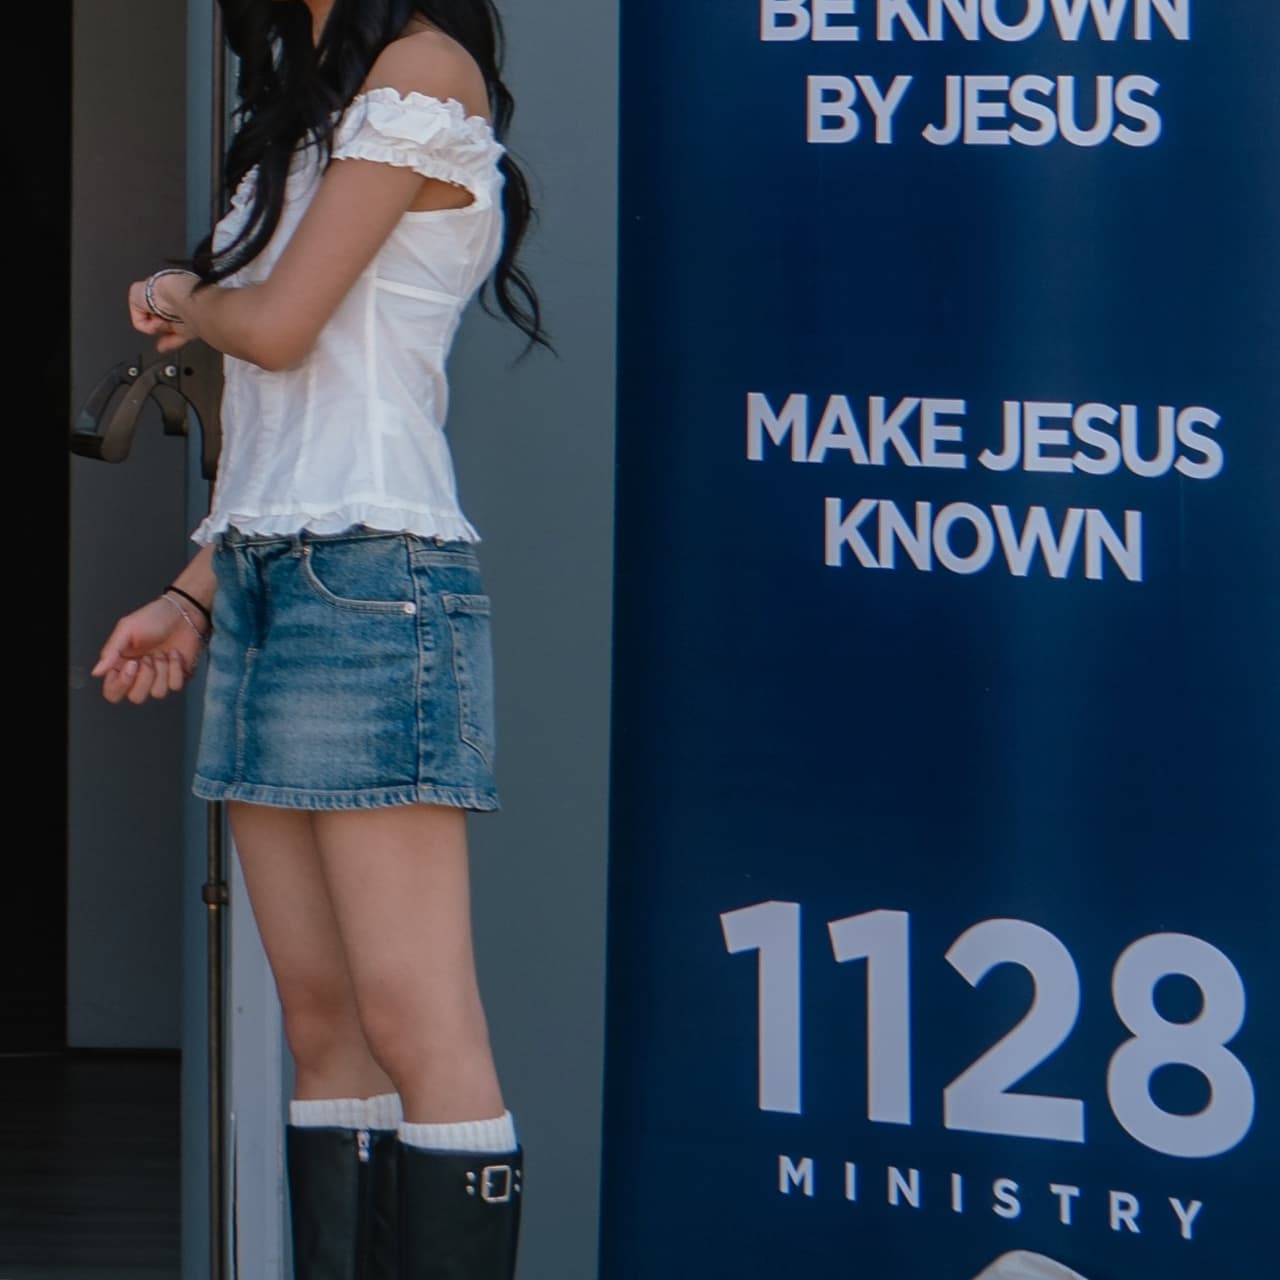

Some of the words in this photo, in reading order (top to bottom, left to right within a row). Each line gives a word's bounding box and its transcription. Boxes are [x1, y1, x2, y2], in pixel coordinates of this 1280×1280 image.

[806, 74, 913, 145] BY
[921, 74, 1162, 147] JESUS
[747, 392, 967, 469] MAKE
[977, 400, 1224, 480] JESUS
[825, 497, 1143, 582] KNOWN
[719, 900, 1255, 1158] 1128
[779, 1155, 1202, 1240] MINISTRY
